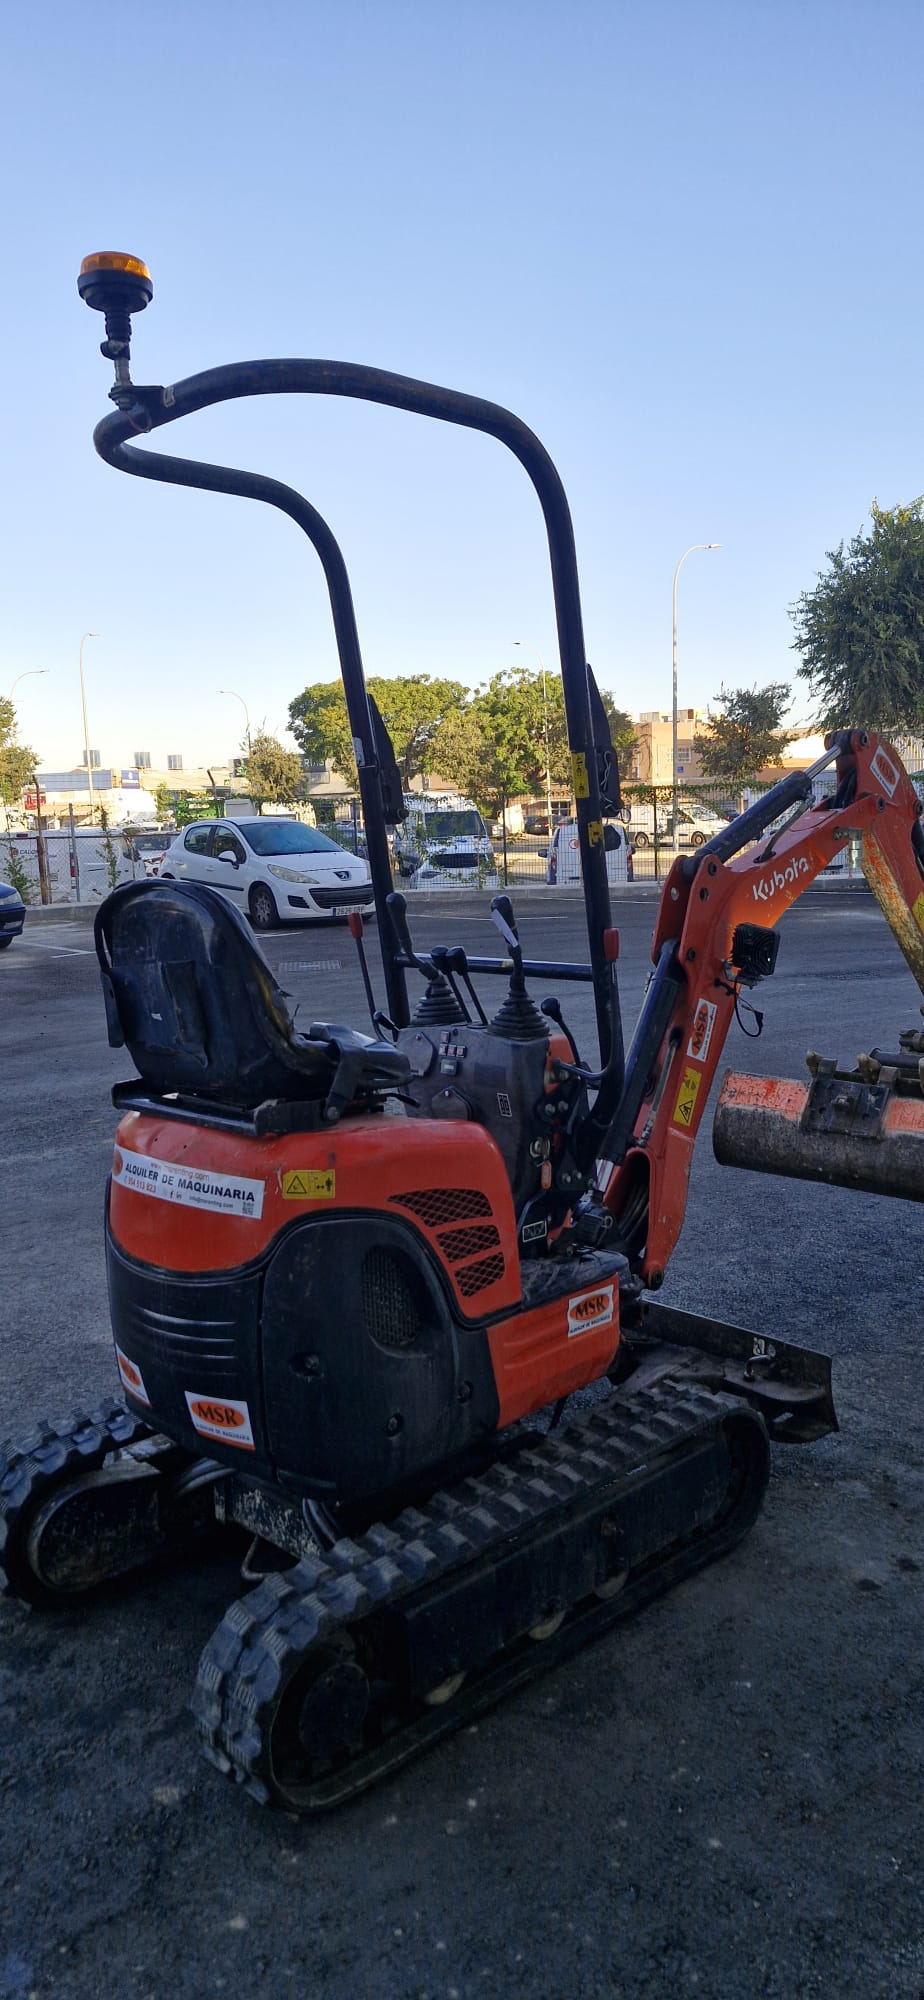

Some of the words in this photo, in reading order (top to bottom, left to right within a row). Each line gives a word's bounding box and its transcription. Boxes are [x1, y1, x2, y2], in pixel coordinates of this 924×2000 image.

[752, 857, 809, 900] Kubota
[693, 1009, 707, 1050] MSR
[125, 1162, 159, 1182] ALQUILER
[161, 1174, 174, 1186] DE
[178, 1178, 255, 1202] MAQUINARIA
[576, 1295, 607, 1320] MSR
[197, 1401, 238, 1426] MSR
